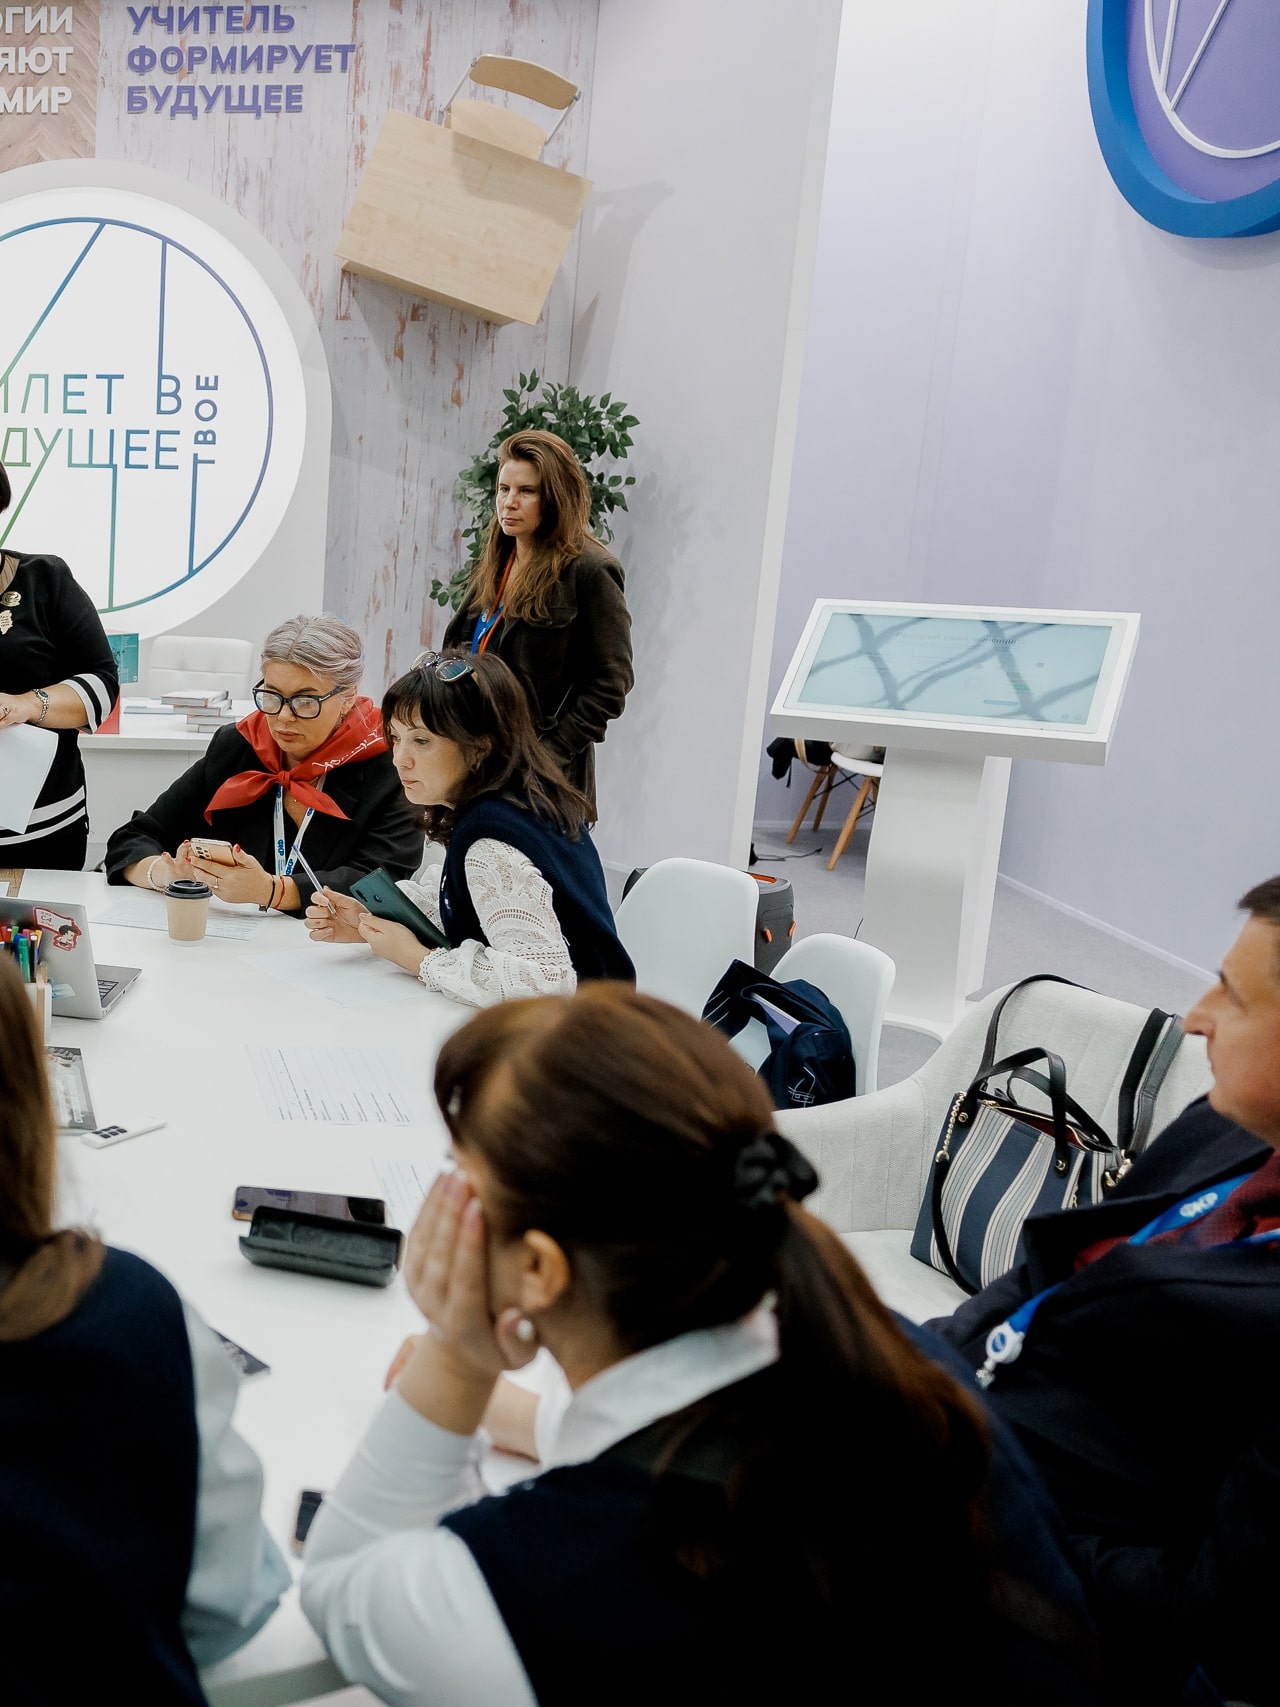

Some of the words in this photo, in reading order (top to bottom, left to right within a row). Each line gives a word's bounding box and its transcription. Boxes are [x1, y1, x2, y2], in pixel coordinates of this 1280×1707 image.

[127, 3, 295, 34] УЧИТЕЛЬ
[127, 43, 355, 74] ФОРМИРУЕТ
[127, 84, 304, 118] БУДУЩЕЕ
[156, 374, 182, 415] В
[193, 375, 219, 465] ТВОЕ
